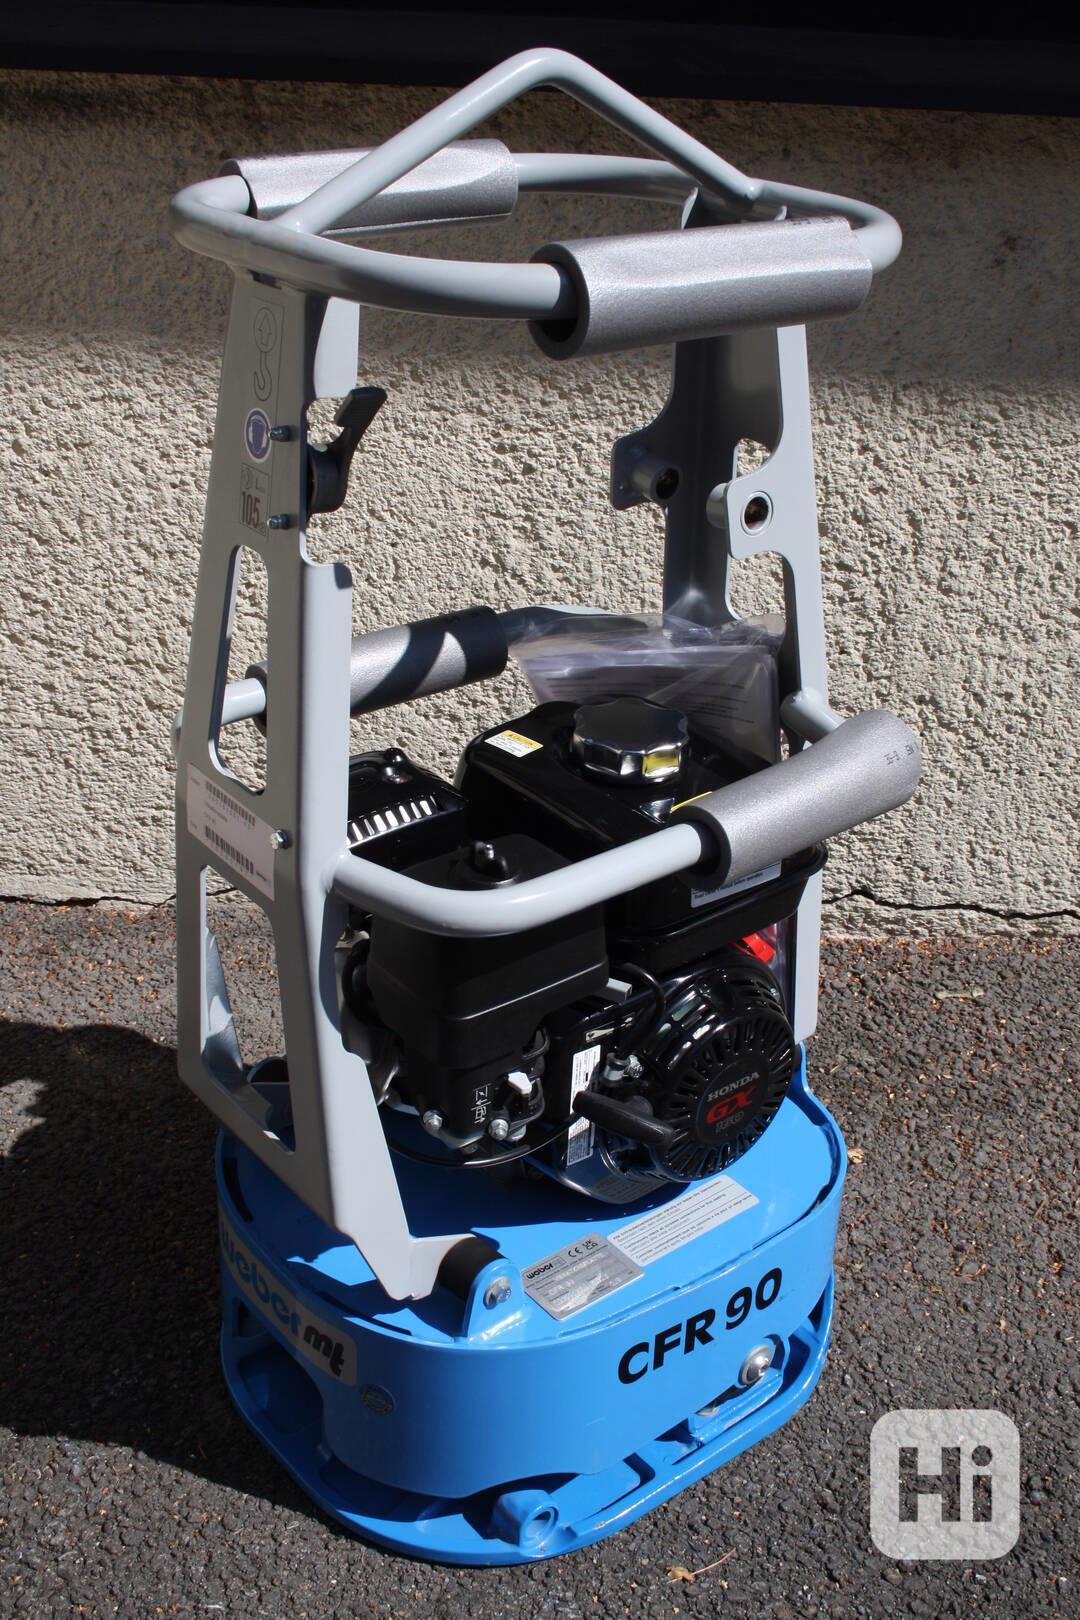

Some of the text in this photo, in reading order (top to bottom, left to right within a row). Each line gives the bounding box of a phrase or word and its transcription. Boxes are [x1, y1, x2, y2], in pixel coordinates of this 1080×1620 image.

[241, 491, 260, 528] 105
[705, 1085, 756, 1124] GX
[707, 1071, 760, 1102] HONDA
[618, 1267, 782, 1384] CFR 90
[303, 1325, 345, 1377] mt
